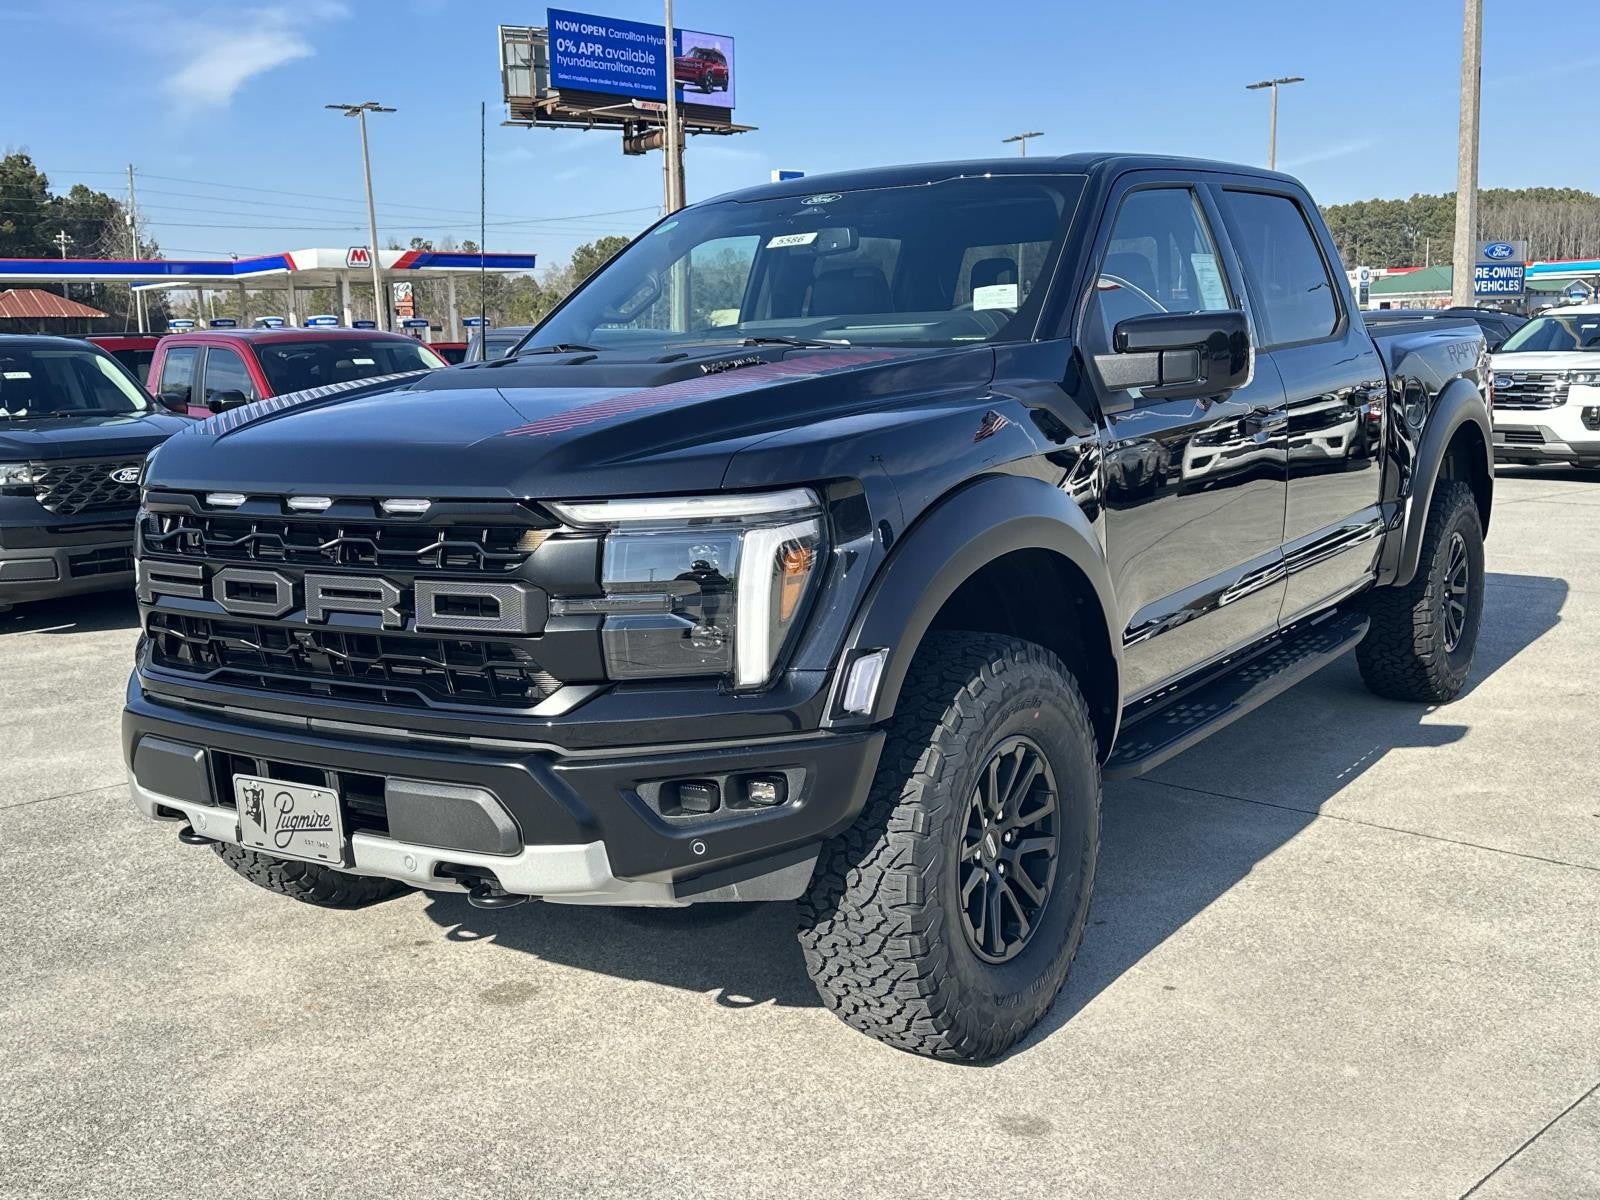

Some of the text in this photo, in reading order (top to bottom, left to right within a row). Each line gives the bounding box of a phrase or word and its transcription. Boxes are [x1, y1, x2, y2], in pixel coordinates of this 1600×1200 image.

[555, 20, 579, 32] NOW
[580, 24, 606, 37] OPEN
[608, 28, 645, 42] Carrollton
[556, 38, 656, 64] 0% APR available
[556, 53, 656, 76] hyundaicarrollton.com
[351, 249, 368, 262] M
[1475, 266, 1524, 279] RE-OWNED
[1474, 280, 1519, 292] VEHICLES
[137, 559, 549, 635] FORD
[273, 791, 334, 849] Pugmire
